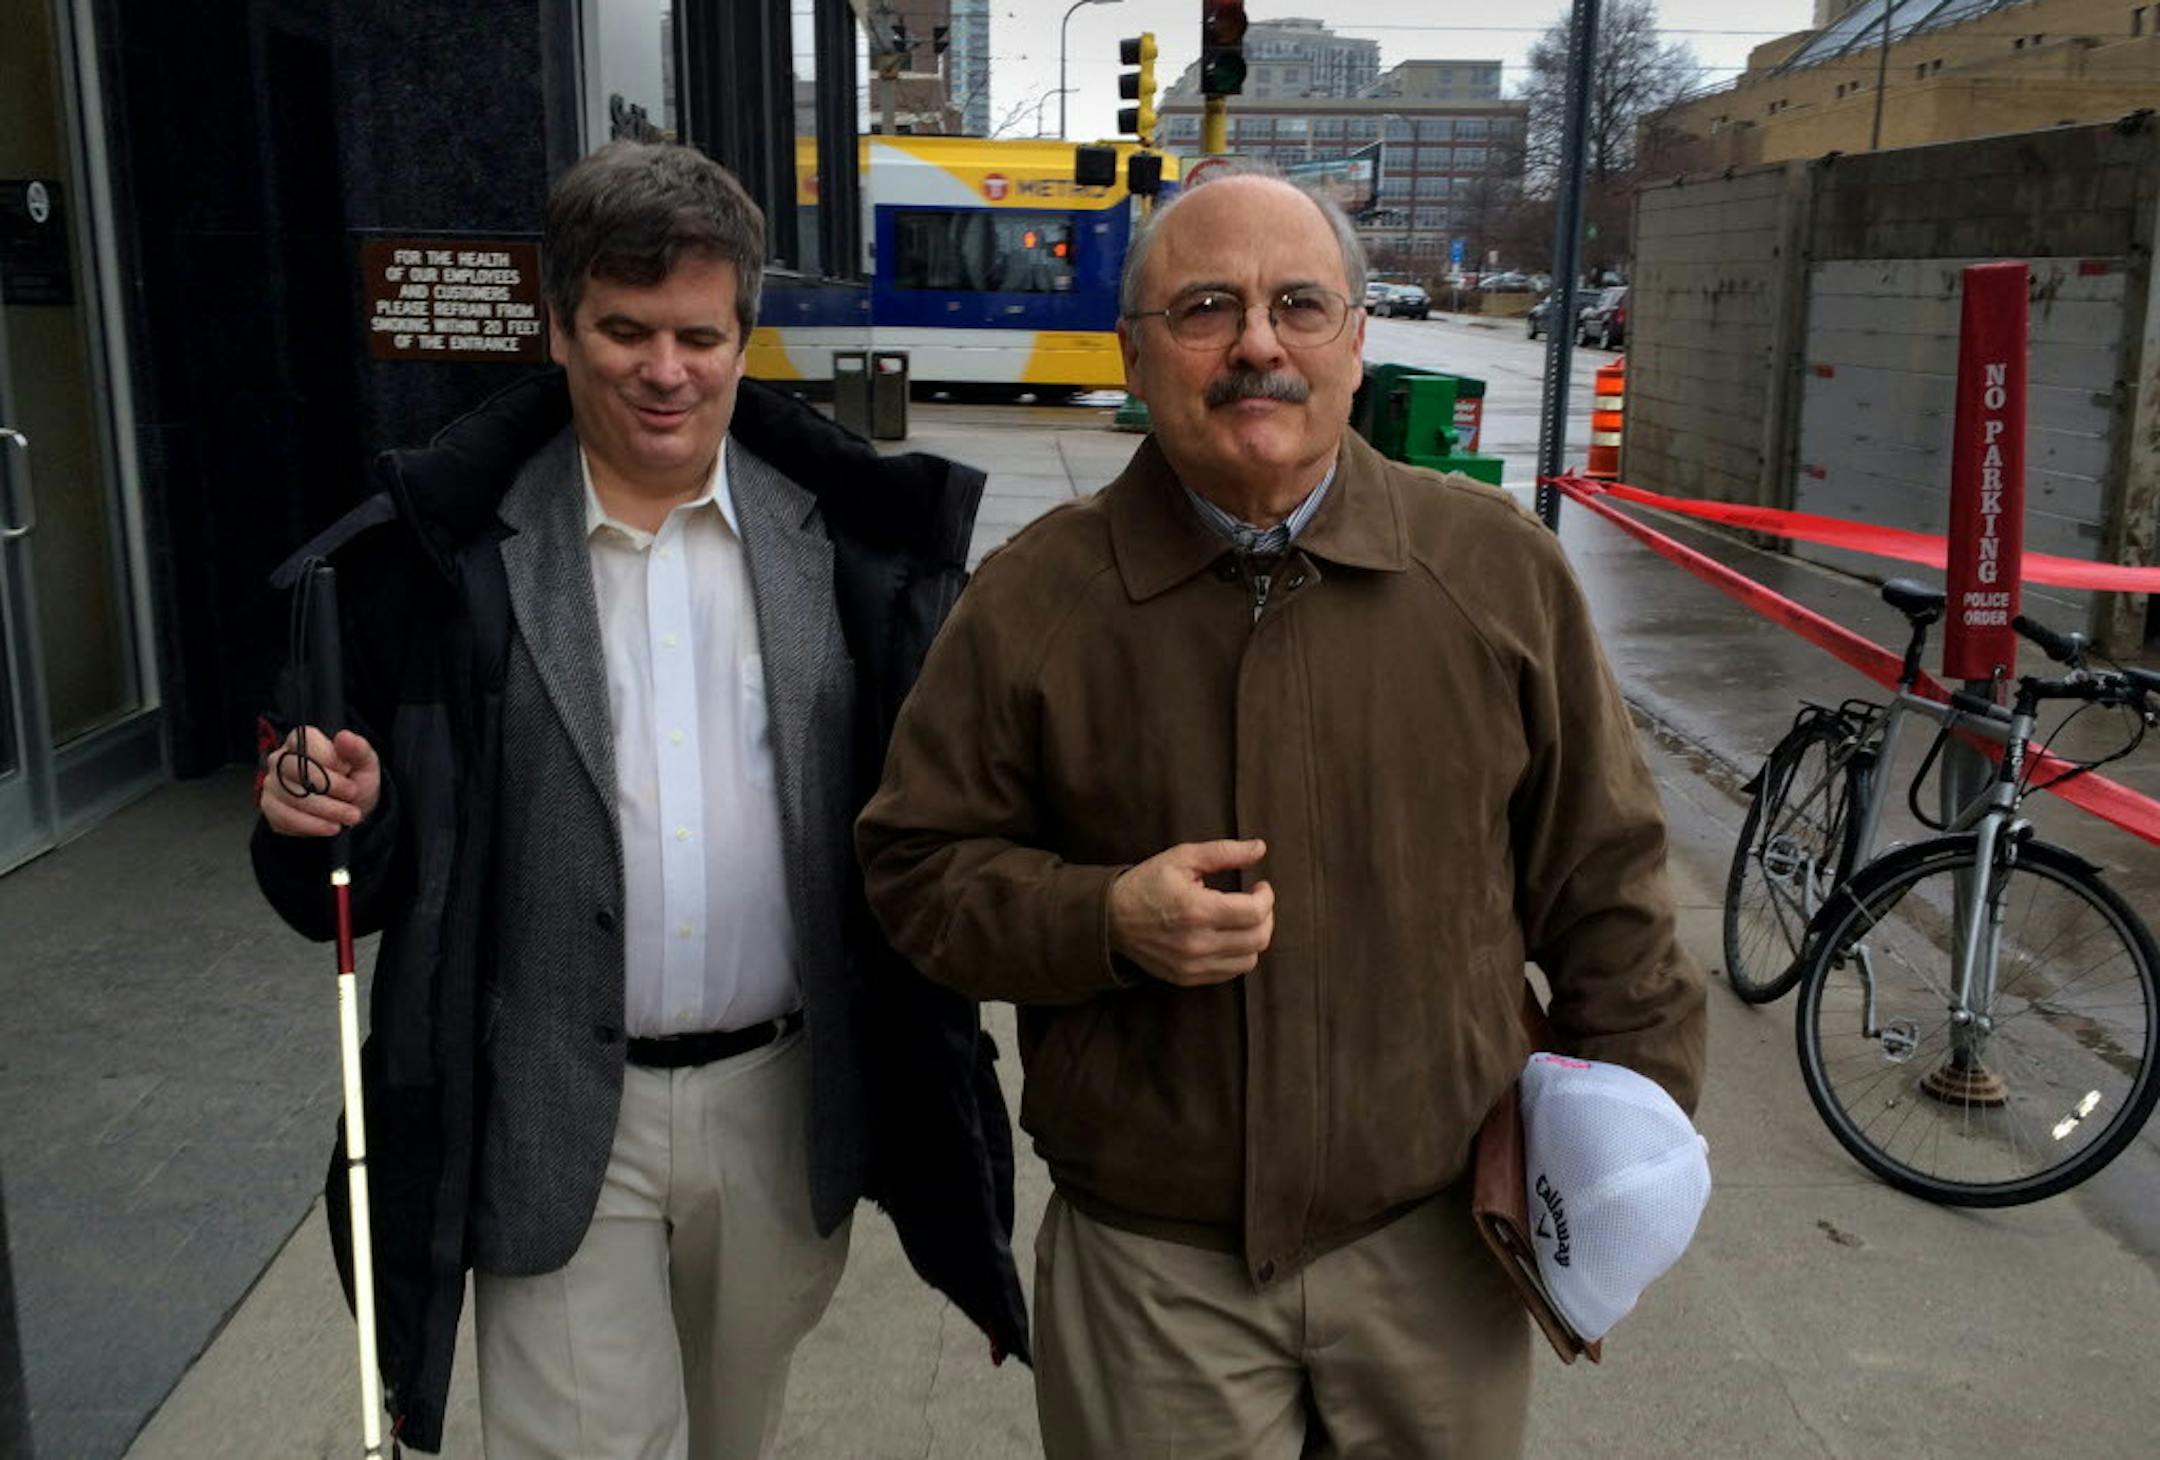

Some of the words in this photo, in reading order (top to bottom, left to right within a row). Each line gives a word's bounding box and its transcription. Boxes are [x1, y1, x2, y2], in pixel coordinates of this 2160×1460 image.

[393, 250, 422, 266] FOR
[425, 250, 454, 266] THE
[457, 252, 511, 268] HEALTH
[384, 266, 405, 282] OF
[408, 267, 439, 283] OUR
[442, 268, 521, 285] EMPLOYEES
[399, 284, 430, 299] AND
[433, 286, 511, 301] CUSTOMERS
[375, 299, 430, 316] PLEASE
[433, 301, 492, 317] REFRAIN
[496, 303, 535, 318] FROM
[370, 316, 431, 332] SMOKING
[433, 318, 480, 334] WITHIN
[482, 319, 504, 335] 20
[507, 320, 542, 335] FEET
[393, 334, 414, 350] OF
[418, 335, 446, 350] THE
[449, 336, 521, 352] ENTRANCE
[1983, 363, 2007, 410] NO
[1977, 420, 2005, 584] PARKING
[1962, 591, 2010, 608] POLICE
[1962, 609, 2008, 626] ORDER
[1536, 1173, 1570, 1267] Callaway
